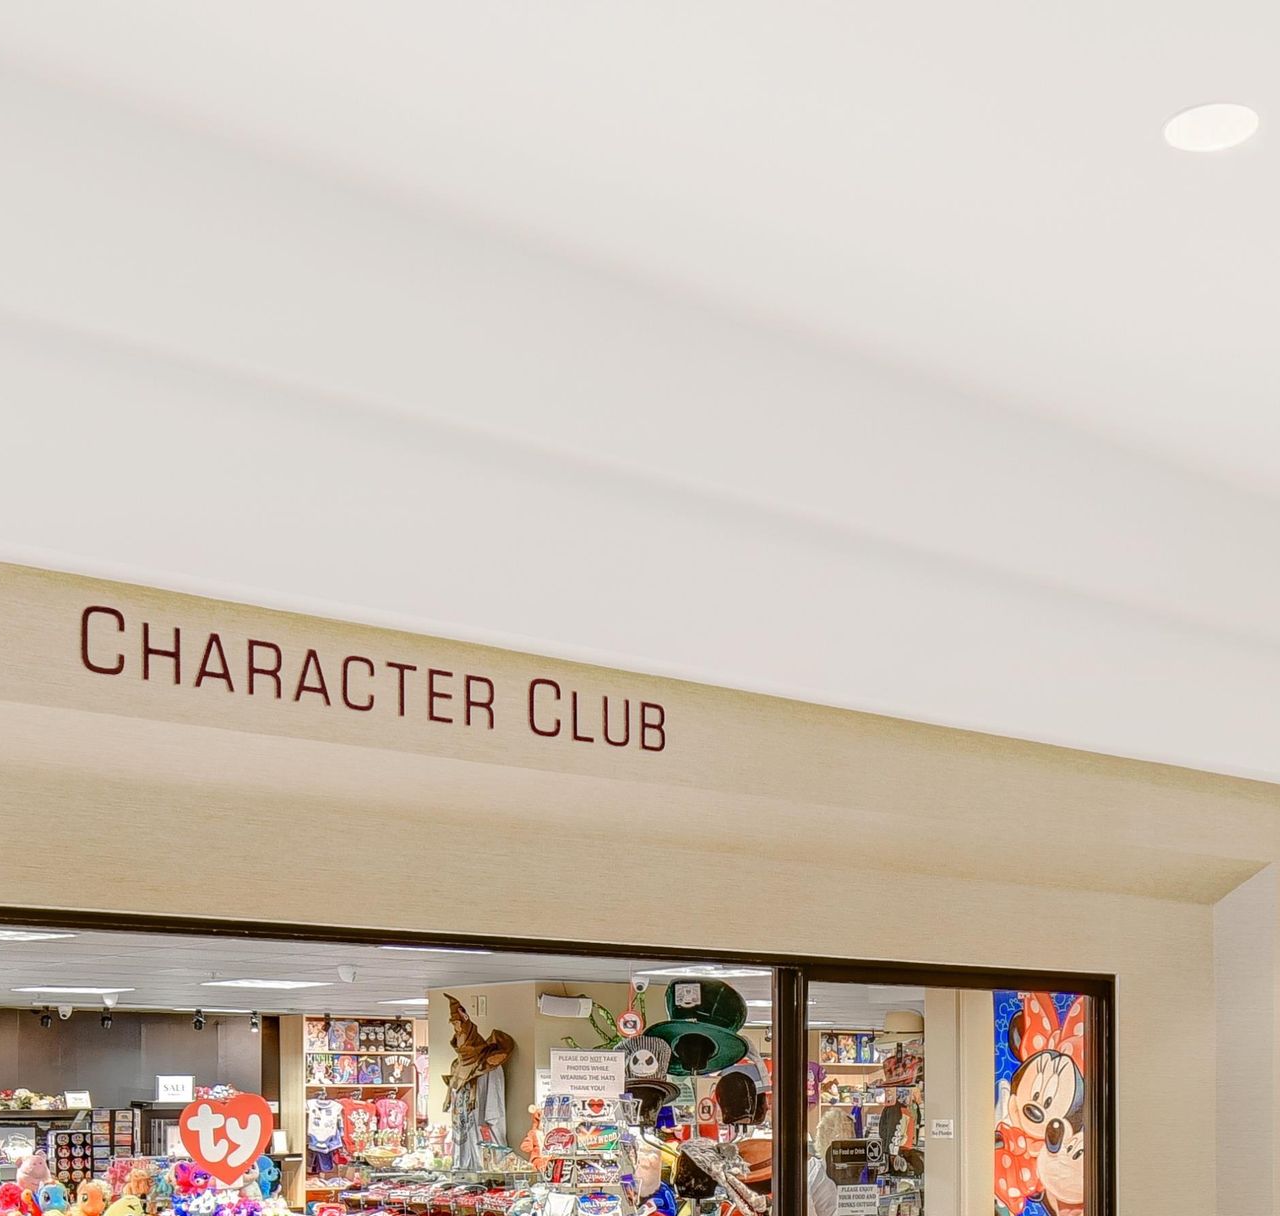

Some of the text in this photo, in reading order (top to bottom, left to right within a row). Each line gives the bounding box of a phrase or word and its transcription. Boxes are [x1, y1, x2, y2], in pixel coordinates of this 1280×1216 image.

[80, 605, 667, 753] CHARACTER CLUB
[186, 1103, 262, 1168] ty
